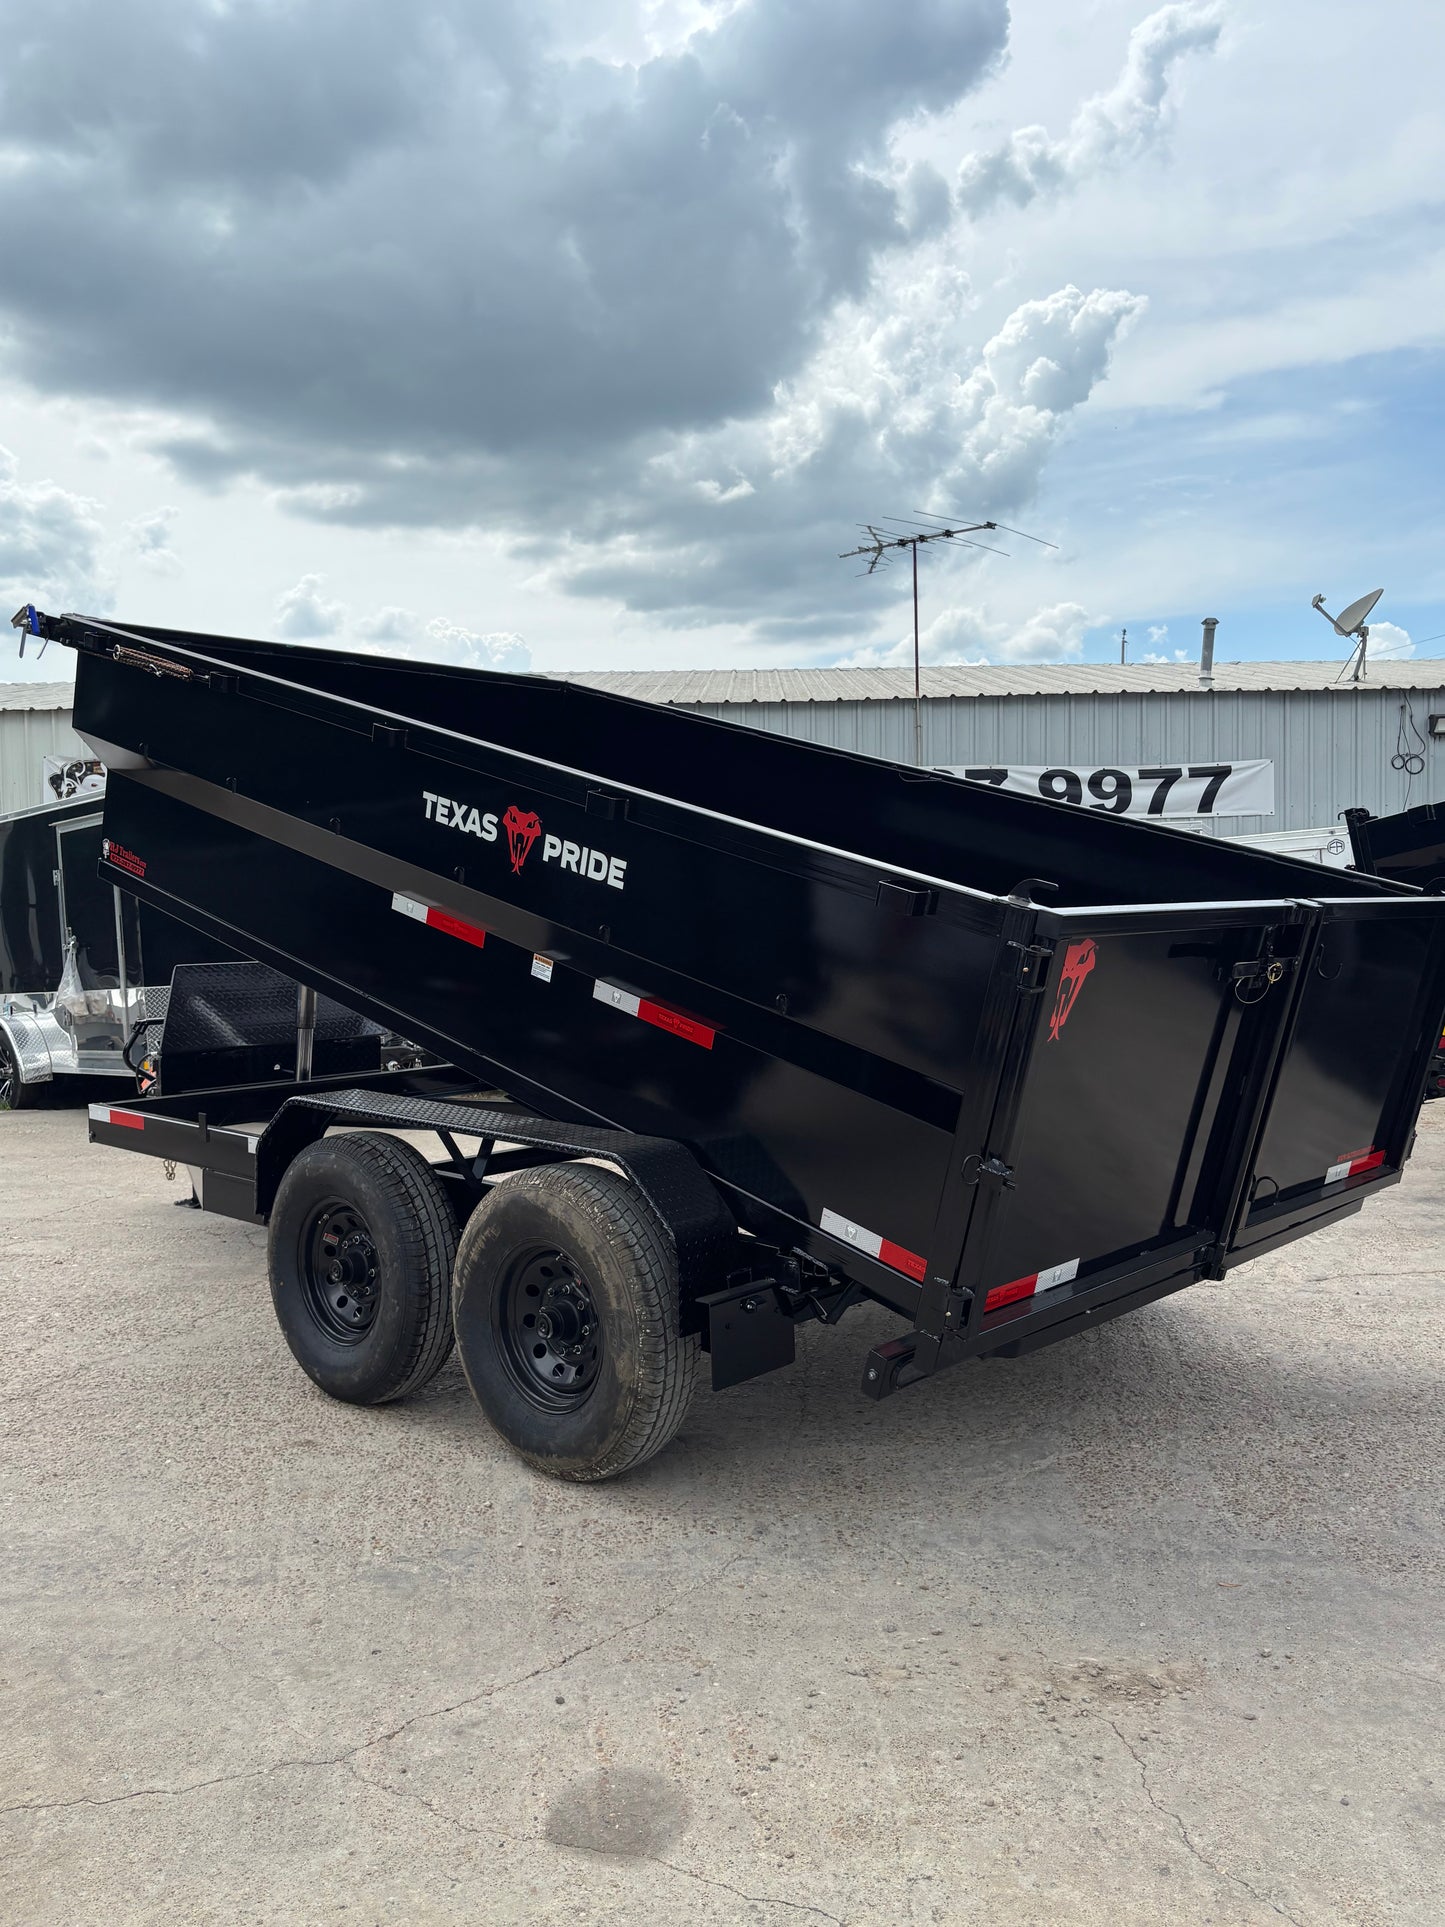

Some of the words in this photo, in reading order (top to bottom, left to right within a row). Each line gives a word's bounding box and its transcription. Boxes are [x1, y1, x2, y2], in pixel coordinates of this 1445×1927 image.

[422, 790, 499, 842] TEXAS
[1038, 765, 1232, 815] 9977
[542, 833, 628, 890] PRIDE
